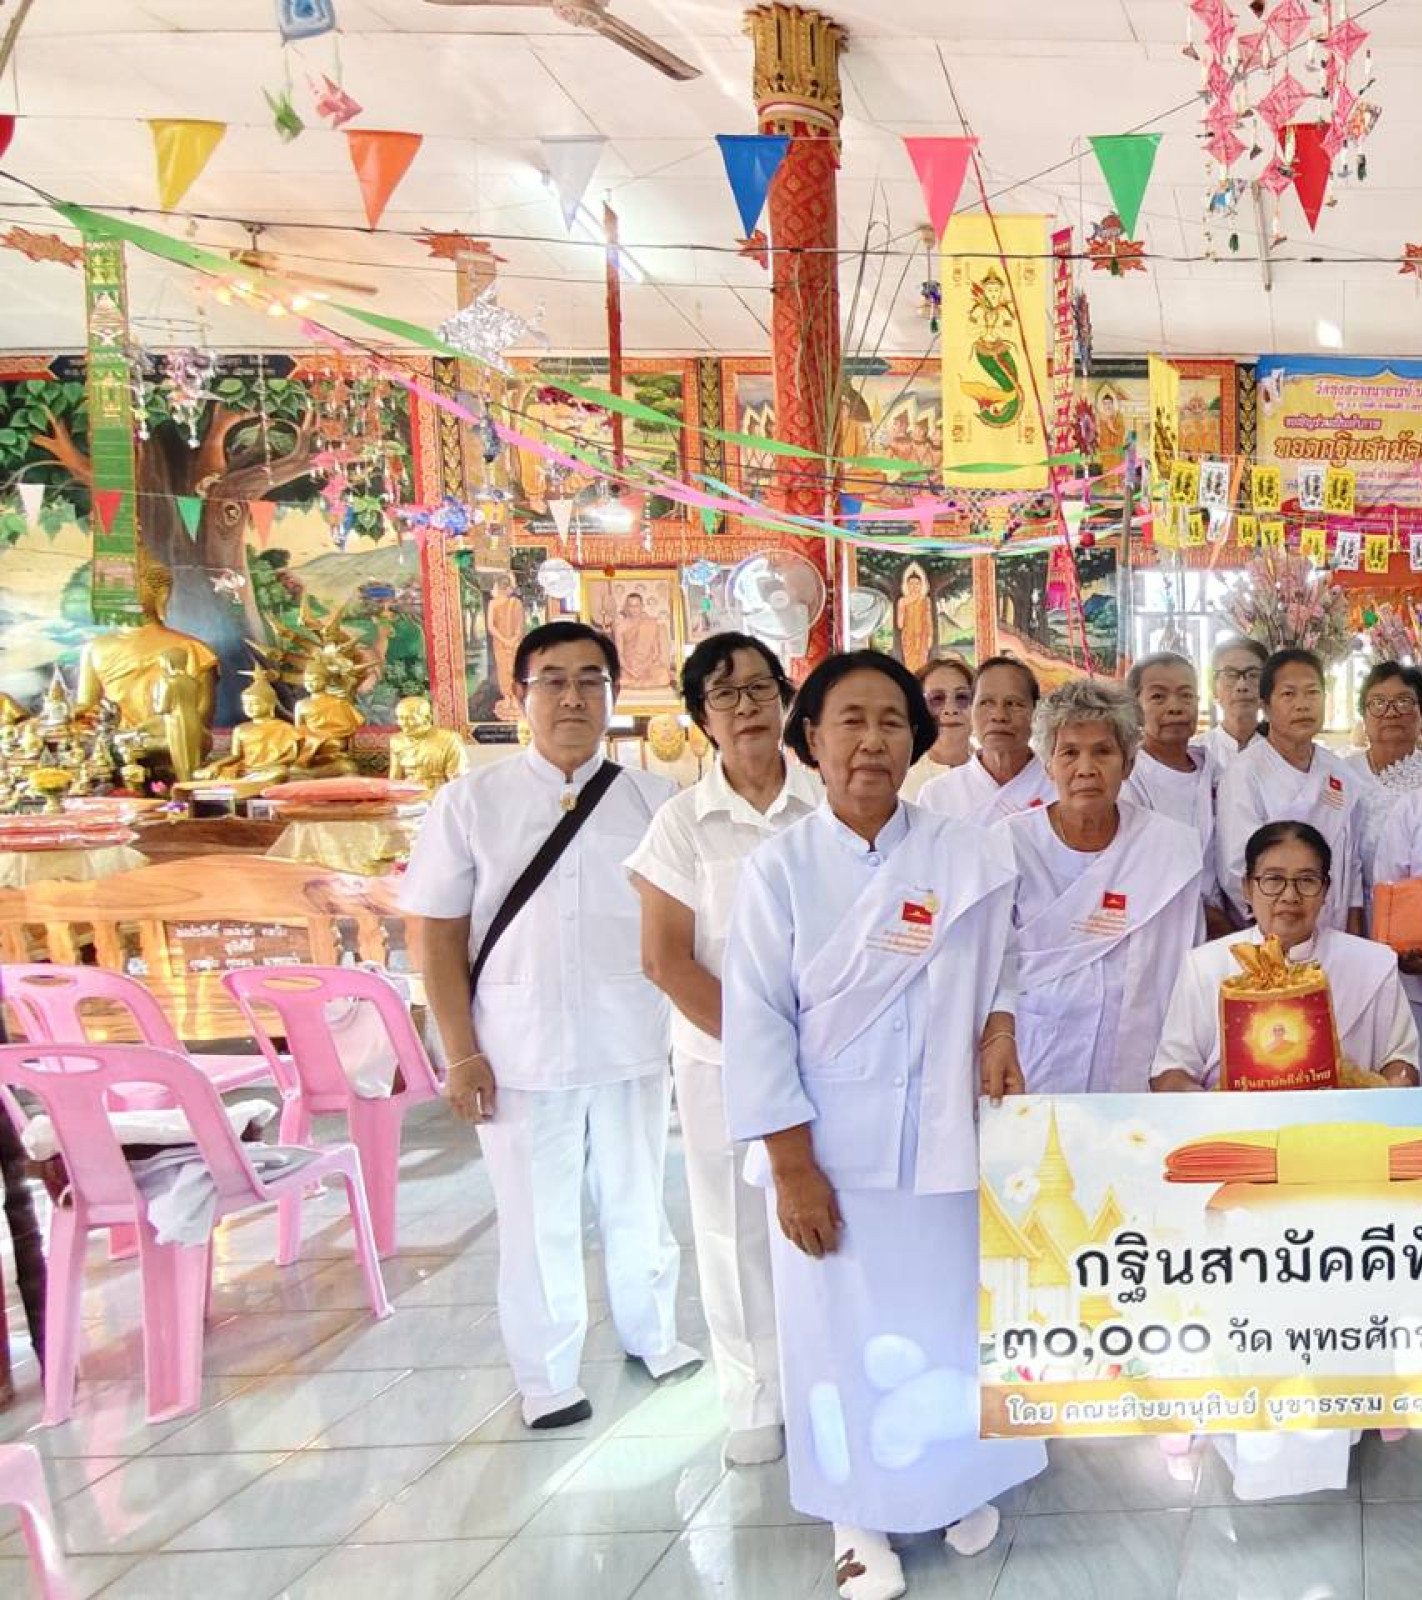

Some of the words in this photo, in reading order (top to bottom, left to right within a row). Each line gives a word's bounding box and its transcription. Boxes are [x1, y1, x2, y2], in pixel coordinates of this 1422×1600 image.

[1003, 1324, 1212, 1365] ๓๐,๐๐๐
[1228, 1318, 1272, 1353] วัด
[1009, 1397, 1053, 1422] โดย
[1066, 1391, 1257, 1424] คณะศิษยานุศิษย์
